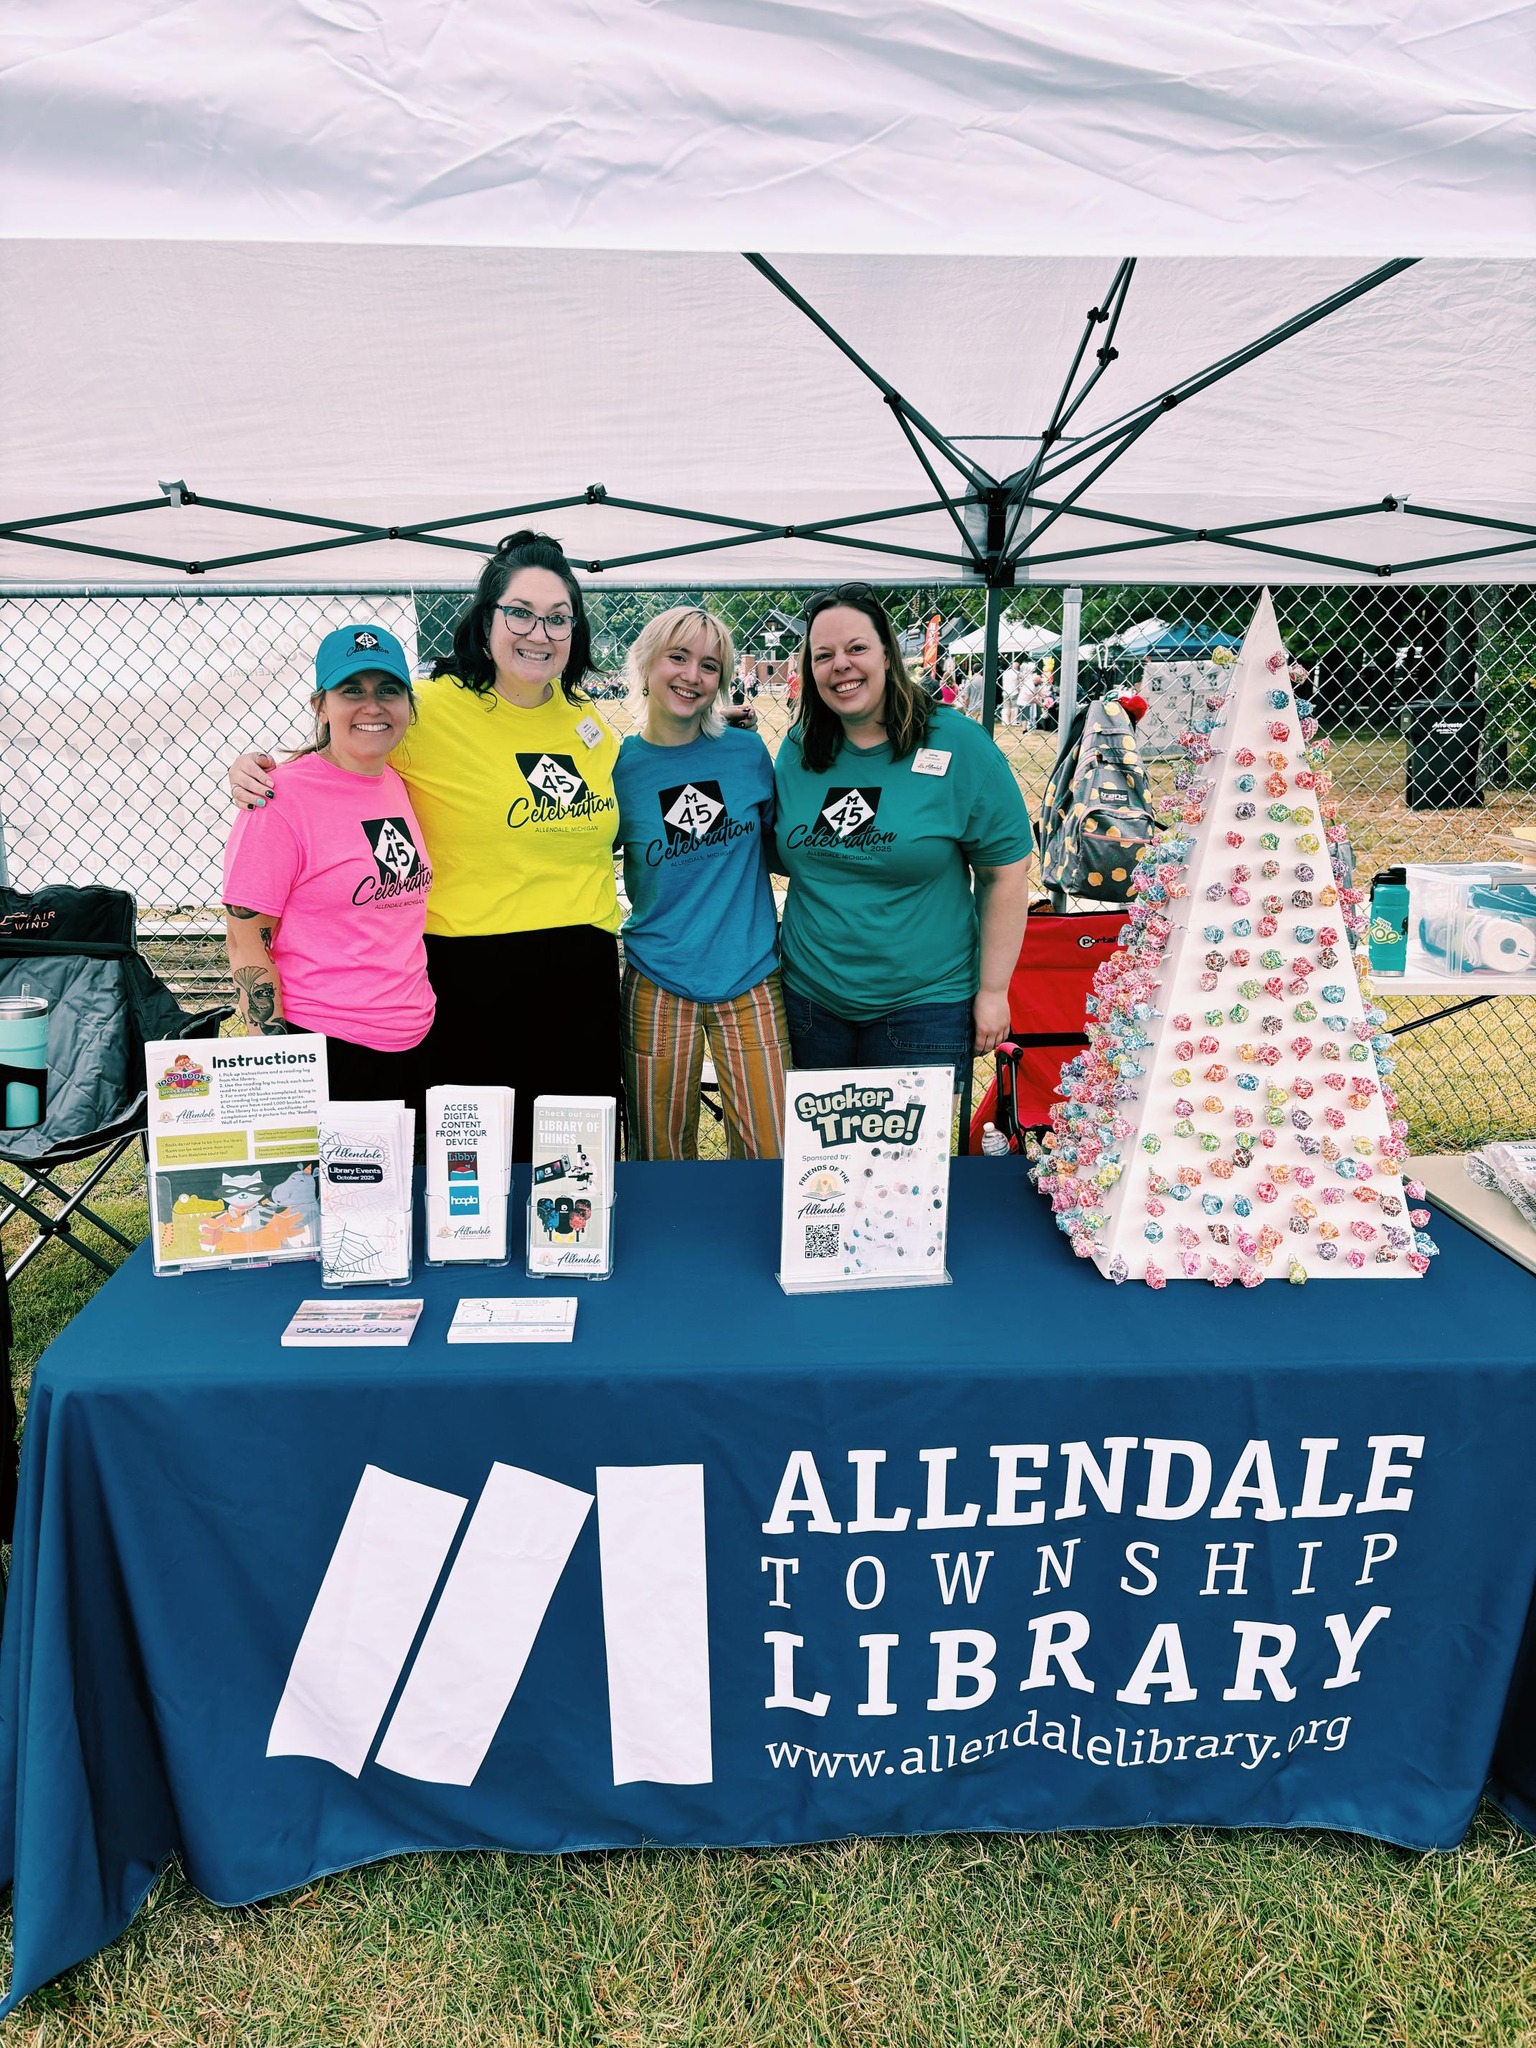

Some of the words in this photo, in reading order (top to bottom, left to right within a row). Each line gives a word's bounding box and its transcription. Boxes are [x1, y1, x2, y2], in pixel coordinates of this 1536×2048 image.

[360, 637, 374, 645] 45
[541, 763, 556, 773] M
[542, 775, 575, 793] 45
[684, 793, 699, 804] M
[845, 796, 860, 805] M
[507, 791, 615, 829] Celebration
[678, 804, 712, 826] 45
[830, 807, 864, 827] 45
[384, 829, 397, 840] M
[786, 824, 898, 853] Celebration
[646, 817, 755, 867] Celebration
[870, 845, 893, 853] 2025
[385, 842, 410, 867] 45
[14, 921, 49, 930] WIND
[212, 1051, 317, 1069] Instructions
[157, 1074, 179, 1087] 1000
[182, 1073, 211, 1082] BOOKS
[444, 1104, 479, 1112] ACCESS
[797, 1086, 892, 1120] Sucker
[175, 1108, 215, 1123] Allendale
[443, 1112, 479, 1120] DIGITAL
[538, 1110, 566, 1118] Check
[441, 1121, 482, 1129] CONTENT
[539, 1120, 584, 1132] LIBRARY
[586, 1121, 600, 1133] OF
[816, 1107, 920, 1143] Tree!
[435, 1130, 461, 1138] FROM
[463, 1129, 488, 1137] YOUR
[539, 1132, 577, 1145] THINGS
[445, 1138, 478, 1146] DEVICE
[326, 1145, 382, 1160] Allendale
[448, 1152, 477, 1163] Libby
[802, 1154, 839, 1162] Sponsored
[329, 1167, 355, 1175] Library
[798, 1164, 827, 1186] FRIENDS
[839, 1170, 850, 1185] THE
[451, 1195, 478, 1206] hoopla
[797, 1202, 846, 1220] Allendale
[453, 1225, 491, 1239] Allendale
[557, 1251, 601, 1267] Allendale
[762, 1434, 1425, 1535] ALLENDALE
[761, 1532, 1397, 1610] TOWNSHIP
[764, 1606, 1392, 1717] LIBRARY
[766, 1709, 1351, 1778] www.allendalelibrary.org
